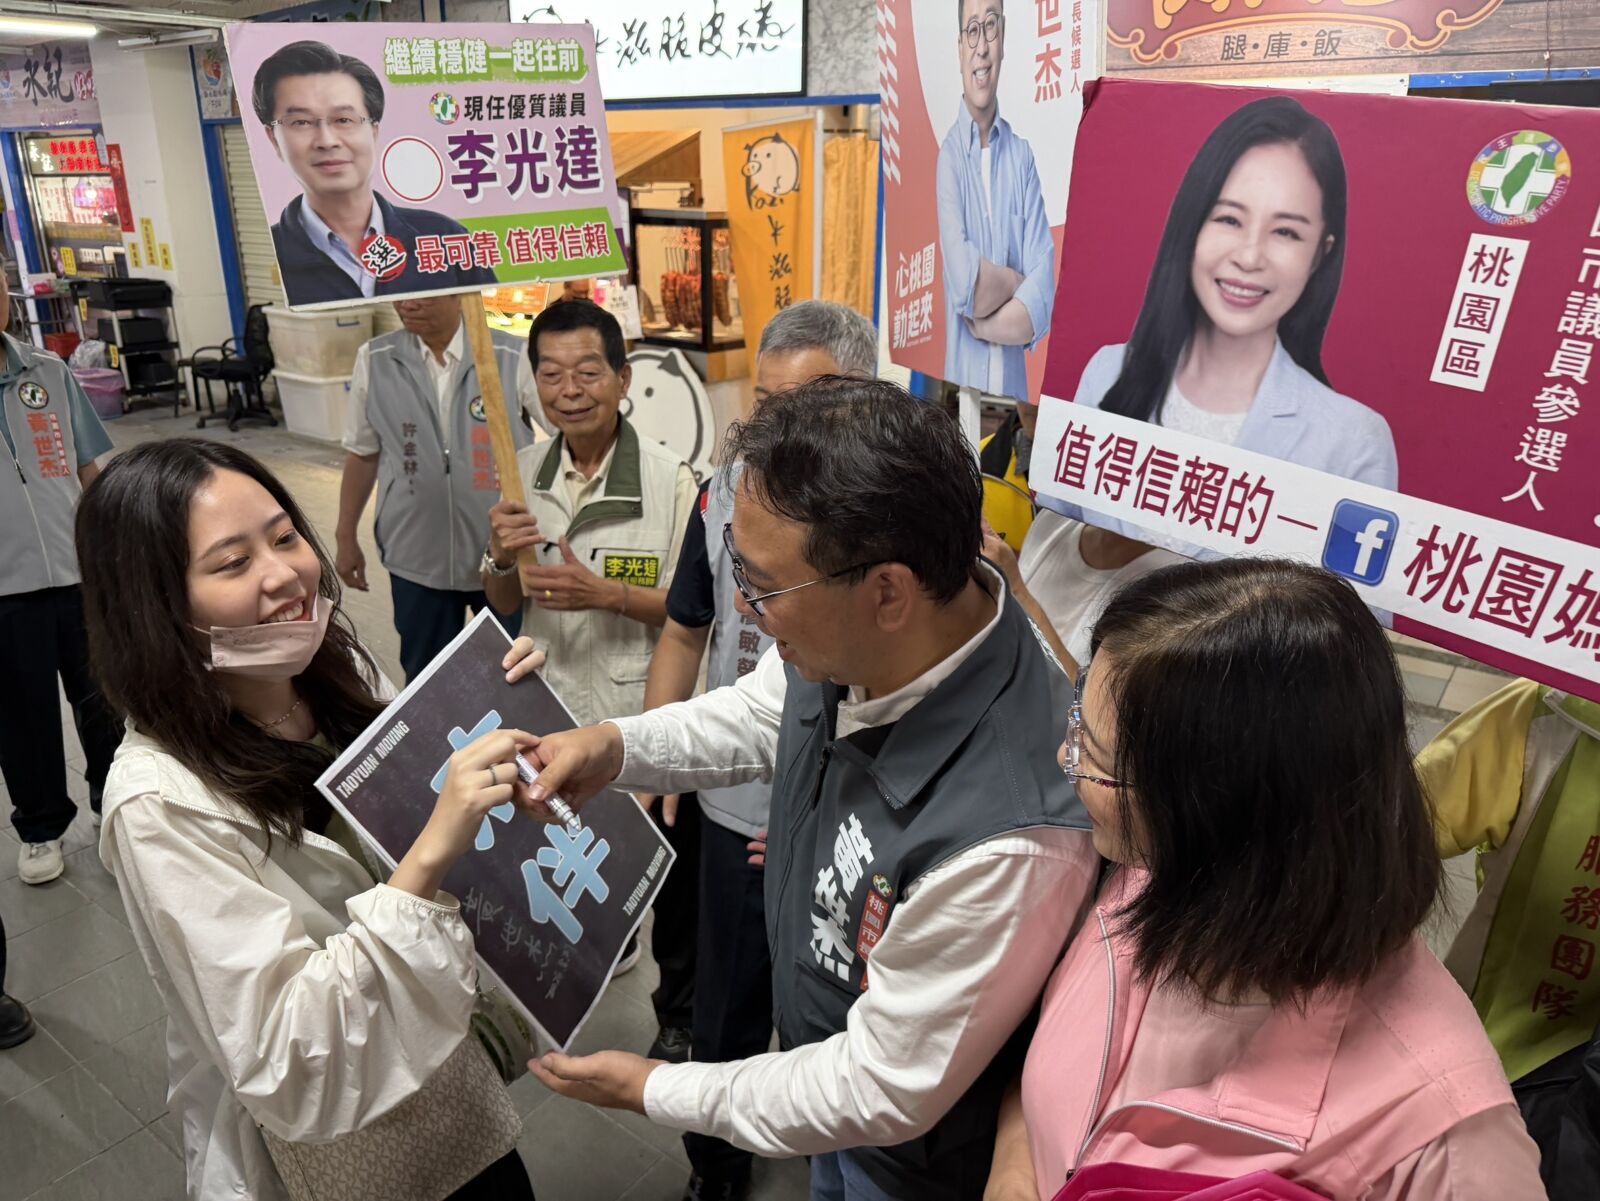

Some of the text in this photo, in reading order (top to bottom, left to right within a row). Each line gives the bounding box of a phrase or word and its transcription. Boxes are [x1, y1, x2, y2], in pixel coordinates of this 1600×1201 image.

[384, 37, 582, 76] 繼續穩健一起往前
[1034, 0, 1062, 103] 世杰
[463, 92, 587, 121] 現任優質議員
[446, 125, 604, 202] 李光達
[361, 235, 407, 277] 選
[415, 222, 611, 273] 最可靠 值得信賴
[894, 242, 936, 298] 心桃園
[893, 291, 933, 349] 動起來
[1441, 244, 1514, 378] 桃園區
[606, 557, 657, 577] 李光達
[335, 720, 411, 800] TAOYUAN MOVING
[1532, 834, 1600, 1021] 服務團隊
